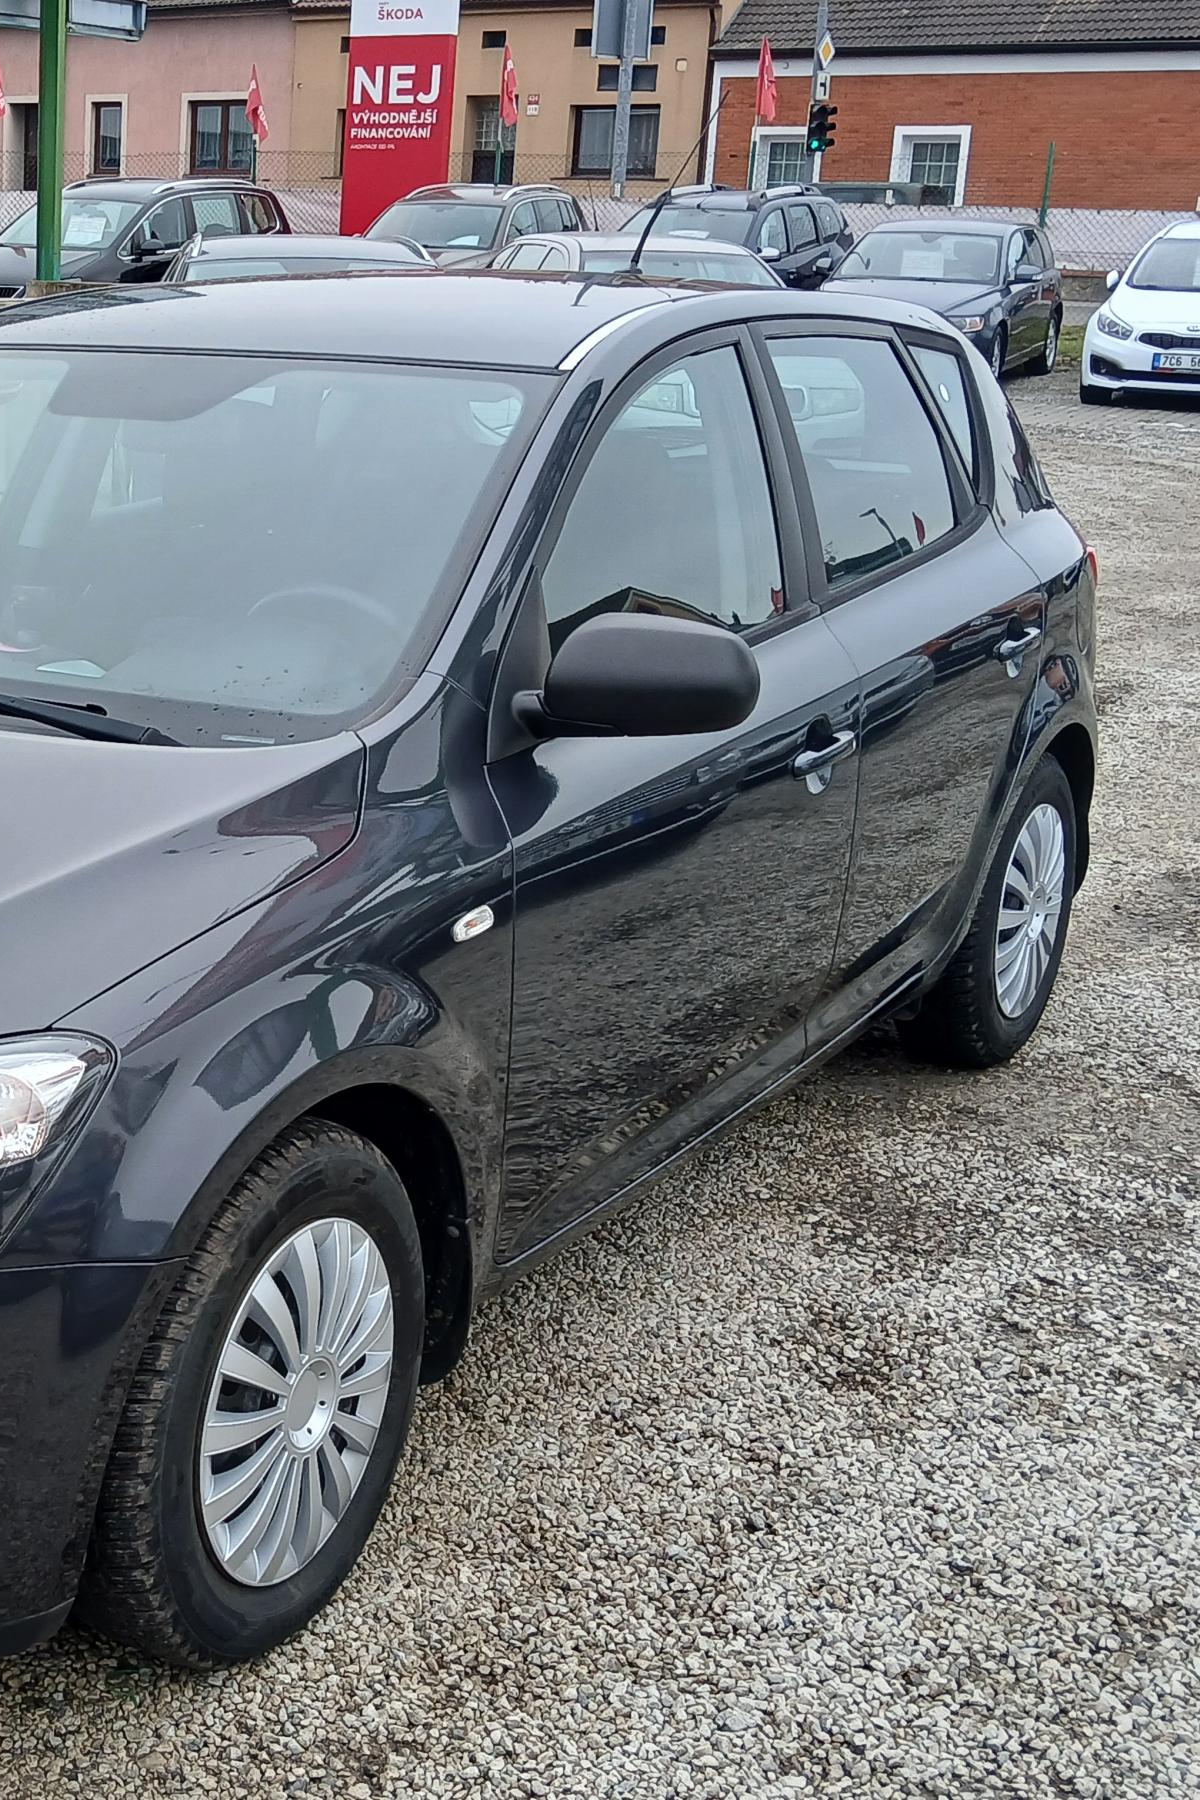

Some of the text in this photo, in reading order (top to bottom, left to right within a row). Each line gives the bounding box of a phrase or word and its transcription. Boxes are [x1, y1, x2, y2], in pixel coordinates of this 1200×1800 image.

[377, 6, 423, 20] ŠKODA
[352, 64, 442, 104] NEJ
[352, 109, 438, 125] VÝHODNĚJŠÍ
[350, 125, 432, 139] FINANCOVÁNÍ
